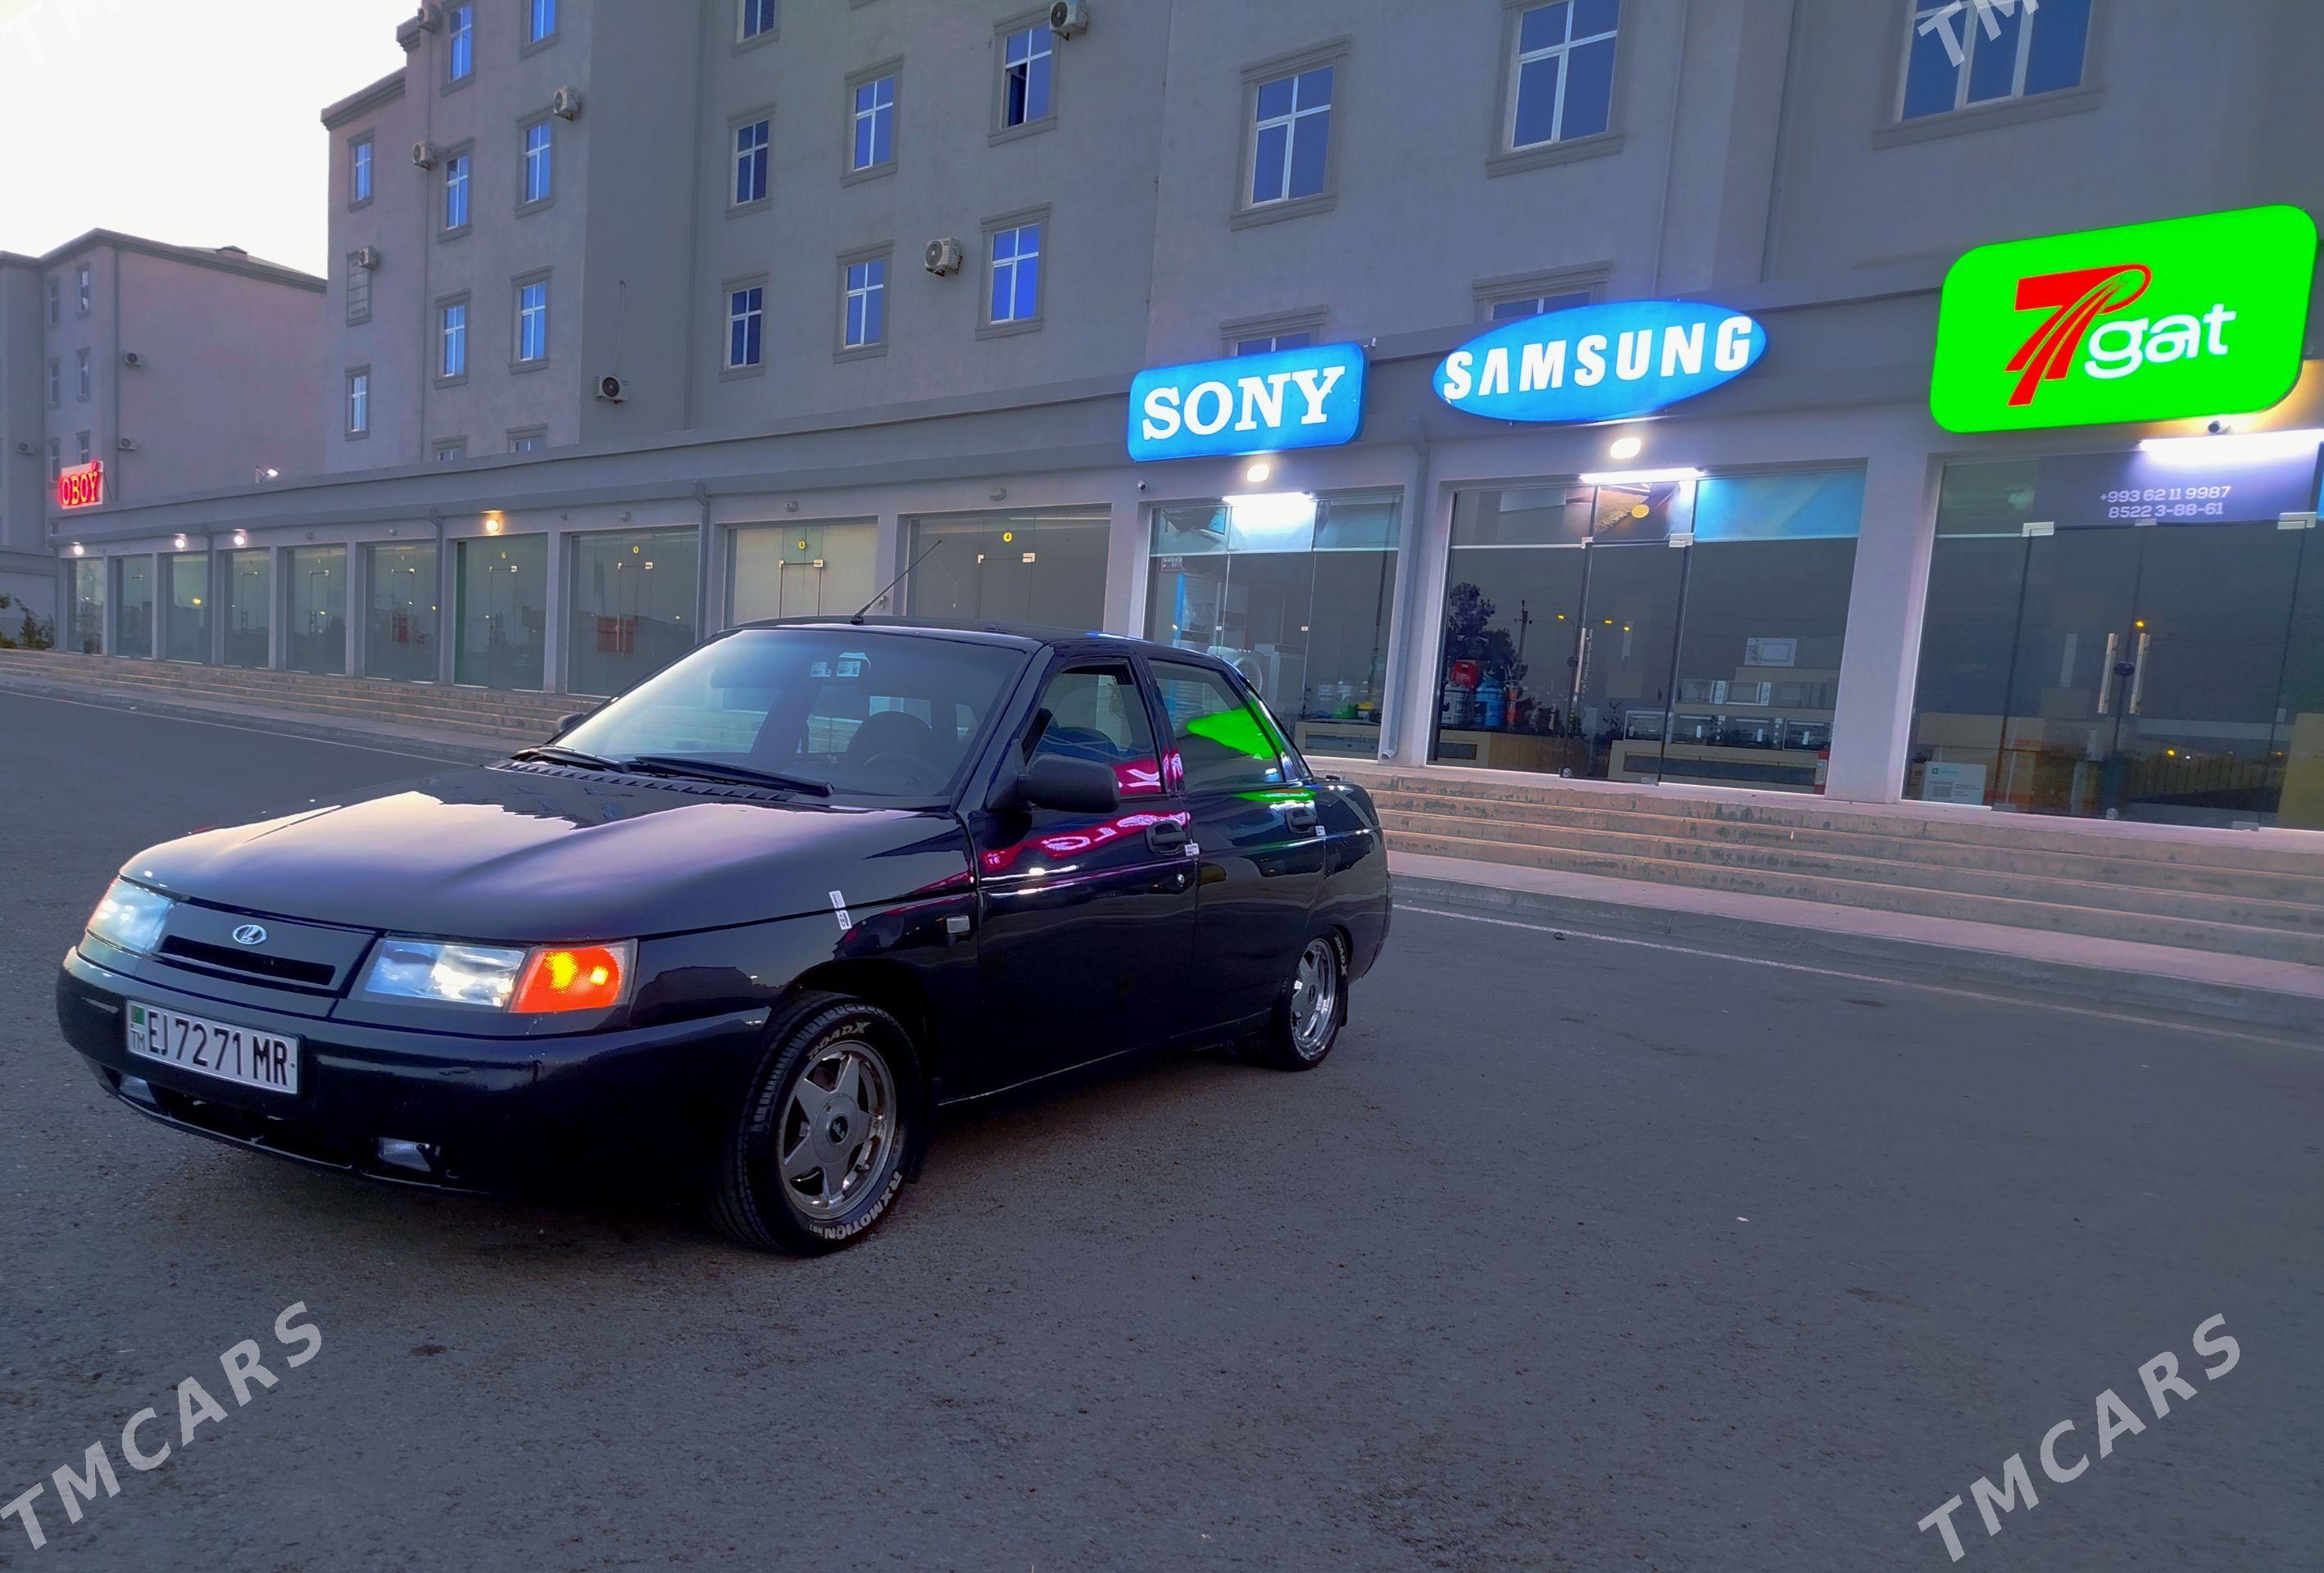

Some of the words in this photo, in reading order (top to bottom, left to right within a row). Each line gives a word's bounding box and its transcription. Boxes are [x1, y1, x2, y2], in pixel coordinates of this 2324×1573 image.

[1443, 316, 1752, 401] SAMSUNG
[1142, 365, 1346, 440] SONY
[2099, 490, 2140, 503] +993
[2143, 489, 2166, 501] 62
[2167, 488, 2181, 501] 11
[2186, 486, 2231, 499] 9987
[2108, 505, 2152, 519] 8522
[2154, 502, 2223, 517] 3-88-61
[175, 1018, 242, 1076] 7271
[252, 1035, 288, 1086] MR
